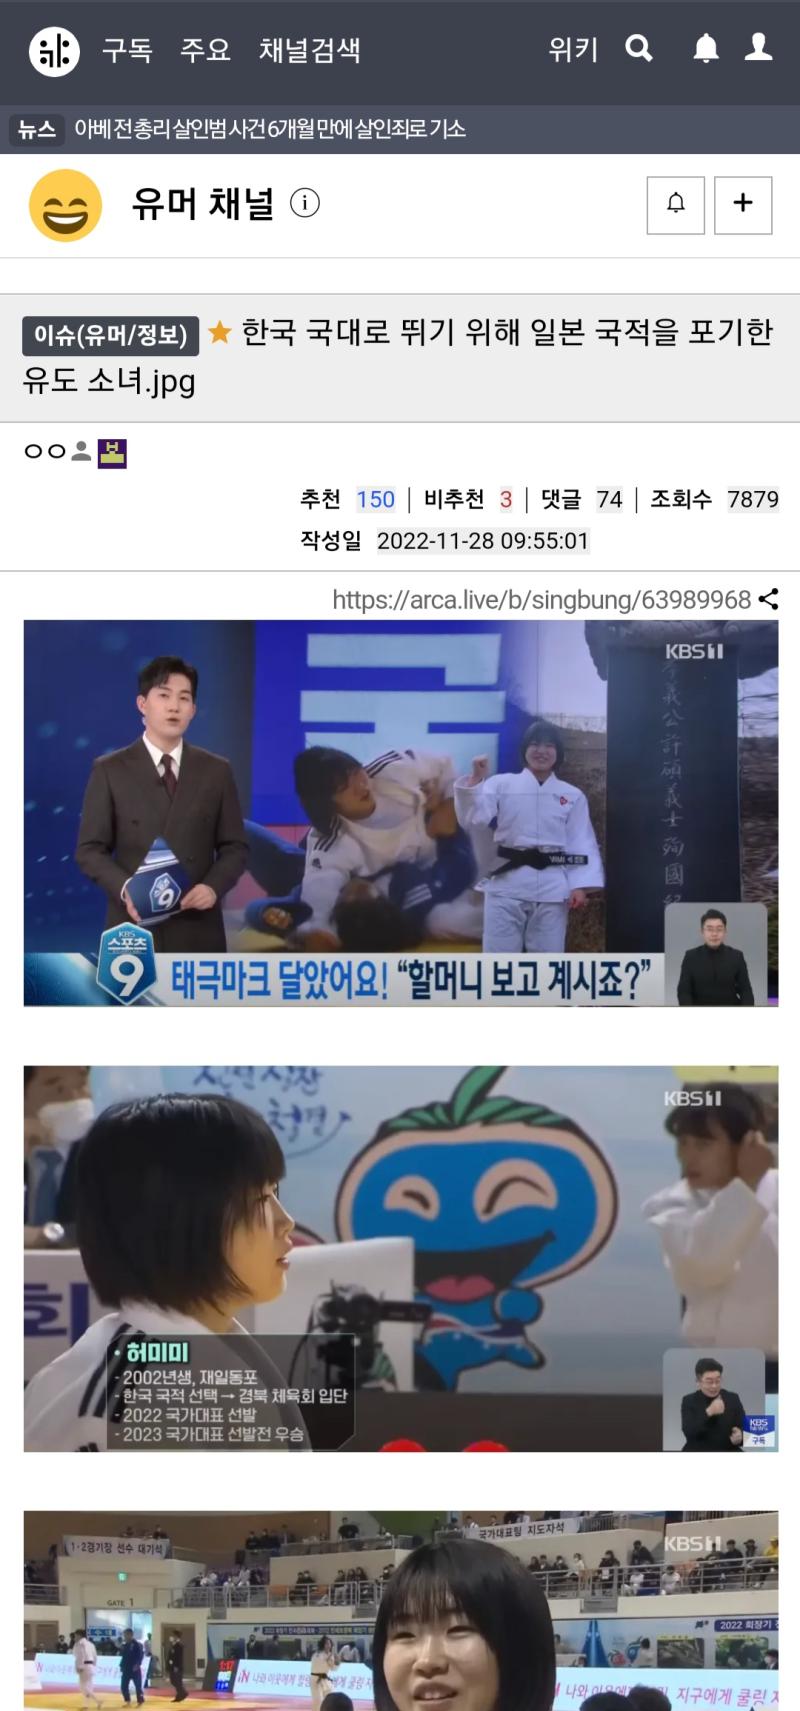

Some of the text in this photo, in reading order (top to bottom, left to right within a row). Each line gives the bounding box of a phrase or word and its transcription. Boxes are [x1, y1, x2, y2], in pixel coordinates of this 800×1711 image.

[103, 38, 359, 63] 구독 주요 채널검색
[549, 37, 596, 62] 위키
[18, 120, 56, 139] 뉴스
[75, 119, 110, 139] 아베
[173, 119, 226, 139] 살인범
[229, 119, 265, 139] 사건
[268, 119, 314, 139] 6개월
[318, 119, 352, 139] 만에
[355, 119, 427, 139] 살인죄로
[430, 119, 466, 139] 기소
[133, 188, 272, 220] 유머 채널
[35, 324, 186, 349] 이슈(유머/정보)
[243, 319, 773, 346] 한국 국대로 뛰기 위해 일본 국적을 포기한
[23, 367, 194, 399] 유도 소녀.jpg
[301, 489, 778, 509] 추천 150 비추천 3 댓글 74 조회수 7879
[301, 531, 586, 551] 작성일 2022-11-28 09:55:01
[334, 589, 751, 614] https://arca.live/b/singbung/63989968
[528, 1522, 564, 1536] 지도자석
[117, 1544, 133, 1554] 선수
[138, 1544, 162, 1555] 대기석
[107, 1599, 125, 1607] GATE
[720, 1620, 743, 1630] 2022
[676, 1687, 732, 1705] 지구에게
[737, 1690, 767, 1708] 쿨링
